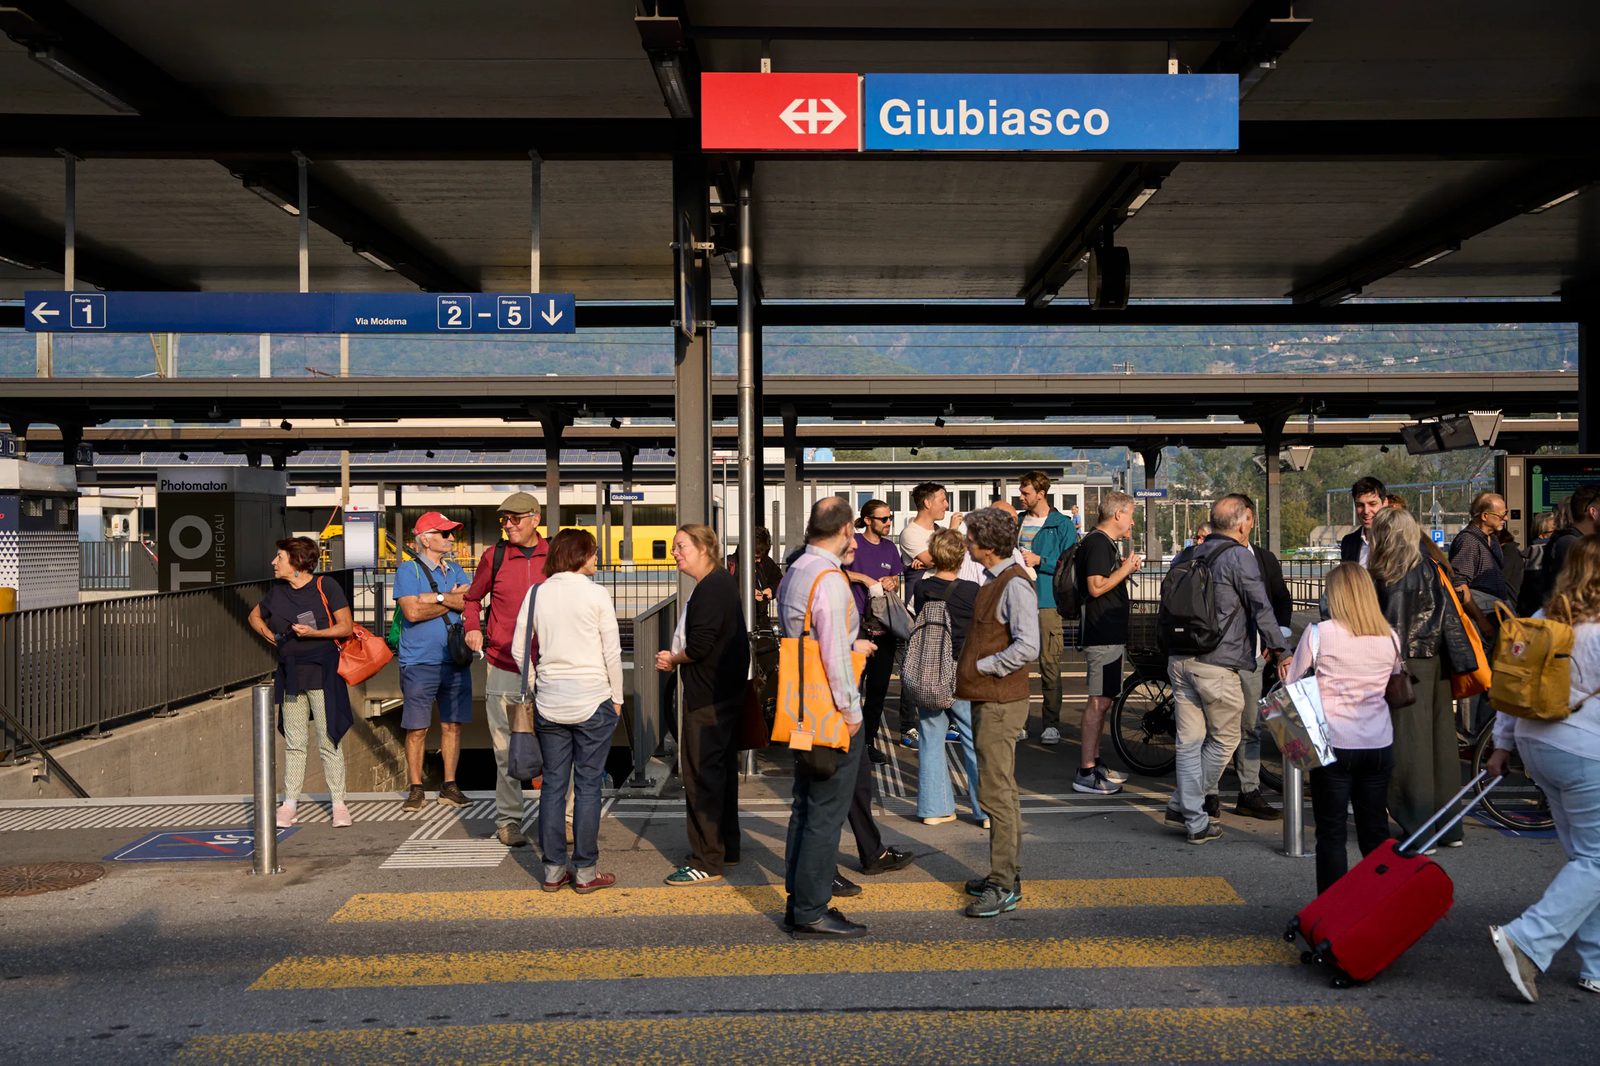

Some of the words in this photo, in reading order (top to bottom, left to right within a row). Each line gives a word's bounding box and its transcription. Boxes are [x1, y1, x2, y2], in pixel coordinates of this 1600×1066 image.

[879, 98, 1110, 136] Giubiasco
[82, 304, 92, 324] 1
[355, 317, 369, 326] Via
[370, 317, 407, 326] Moderna
[447, 305, 462, 325] 2
[507, 306, 522, 326] 5
[9, 441, 15, 454] D
[160, 479, 228, 491] Photomaton
[214, 514, 226, 568] UFFICIALI
